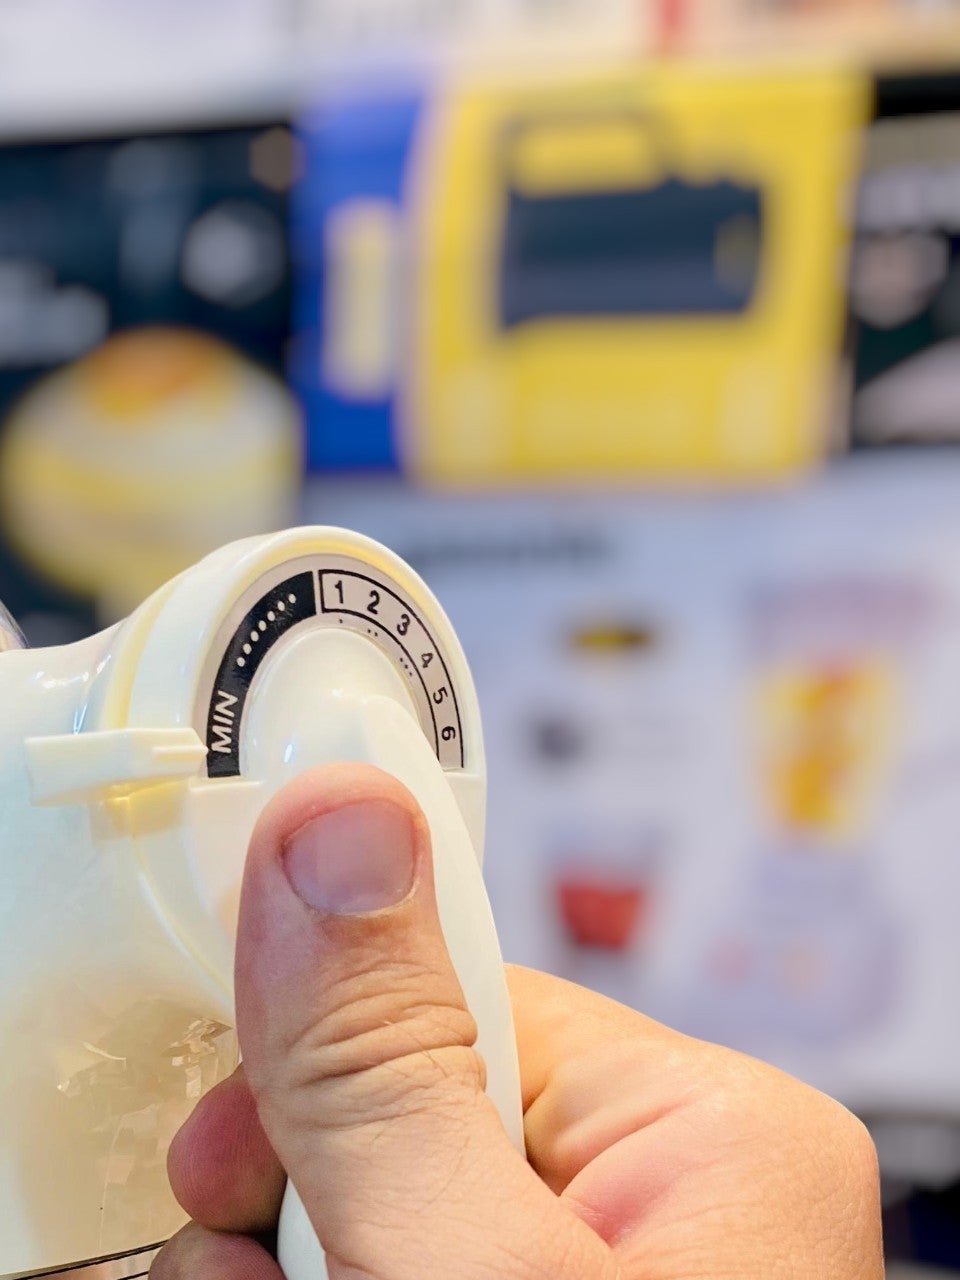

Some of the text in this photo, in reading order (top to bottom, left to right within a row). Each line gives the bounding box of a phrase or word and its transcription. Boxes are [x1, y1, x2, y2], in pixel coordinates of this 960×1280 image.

[334, 580, 456, 741] 1 2 3 4 5 6
[211, 690, 239, 754] MIN
